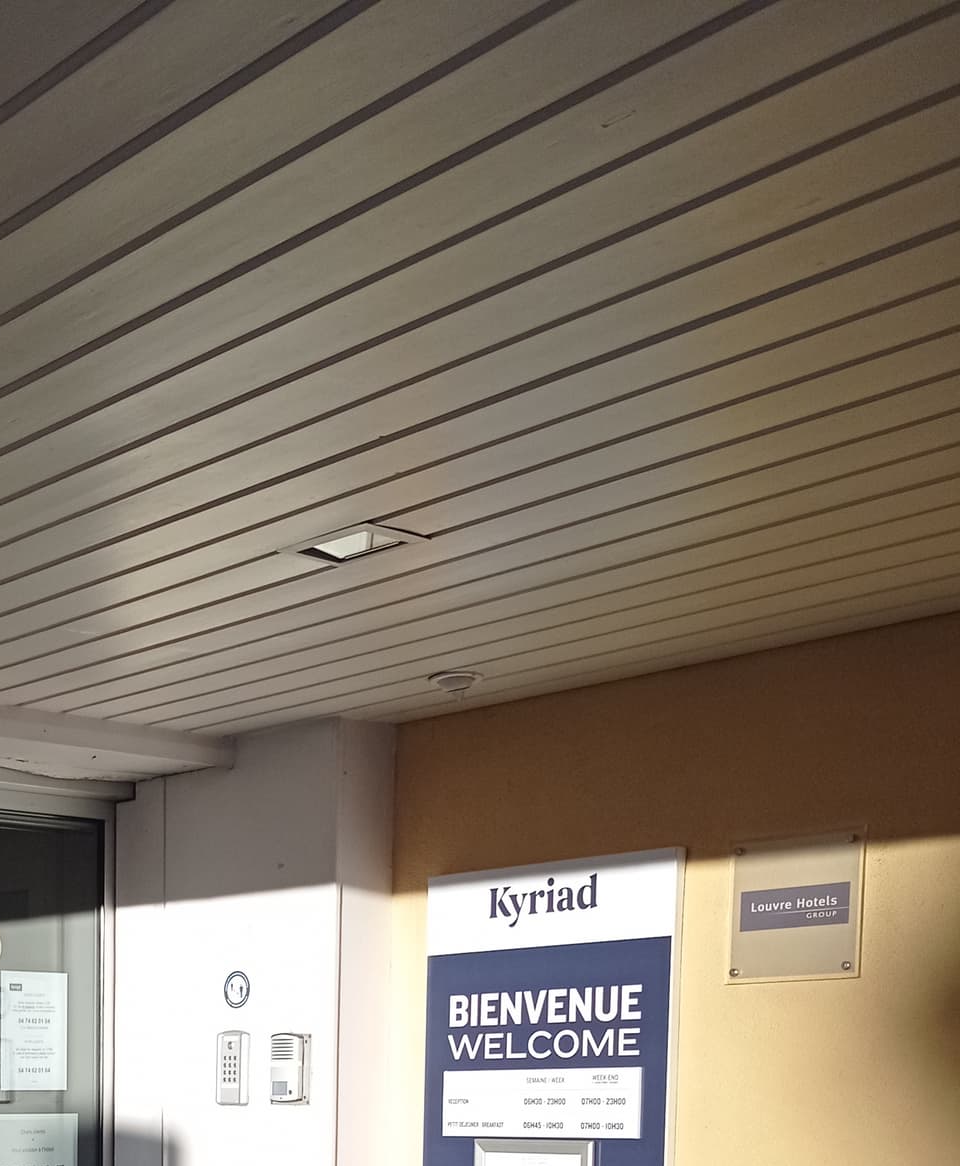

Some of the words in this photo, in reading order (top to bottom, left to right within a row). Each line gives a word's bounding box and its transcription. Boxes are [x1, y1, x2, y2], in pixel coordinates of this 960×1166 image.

[489, 873, 598, 927] Kyriad
[751, 900, 792, 913] Louvre
[796, 896, 838, 909] Hotels
[806, 910, 838, 919] GROUP
[449, 983, 643, 1028] BIENVENUE
[447, 1028, 641, 1060] WELCOME
[546, 1097, 566, 1106] 23H00
[581, 1097, 601, 1106] 07H00
[605, 1097, 626, 1106] 23H00
[580, 1122, 601, 1130] 07H00
[605, 1122, 624, 1130] 10H30
